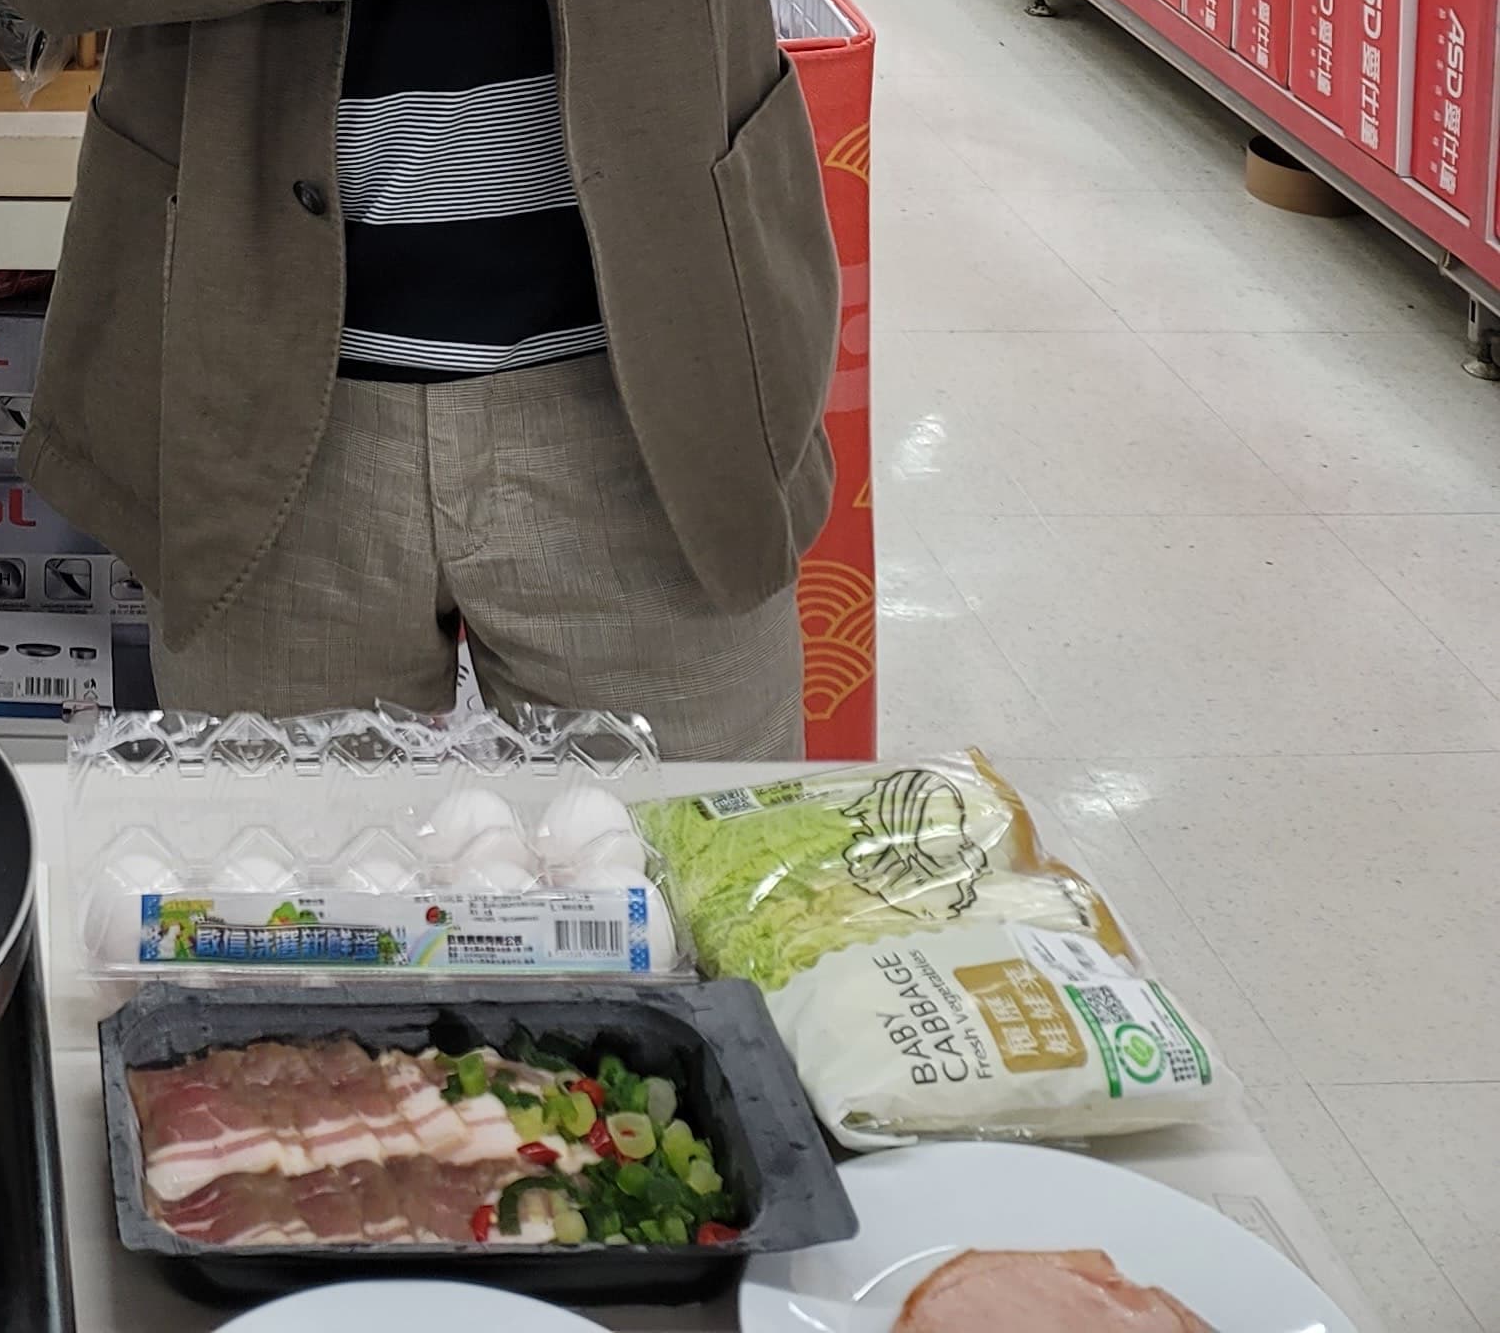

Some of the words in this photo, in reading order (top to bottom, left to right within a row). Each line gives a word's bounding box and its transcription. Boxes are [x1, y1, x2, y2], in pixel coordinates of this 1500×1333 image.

[1446, 8, 1465, 99] ASD
[873, 950, 969, 1083] CABBAGE
[909, 949, 970, 1025] Vegetables
[1002, 962, 1080, 1055] 娃娃菜
[875, 1013, 937, 1085] BABY
[963, 1026, 993, 1080] Fresh
